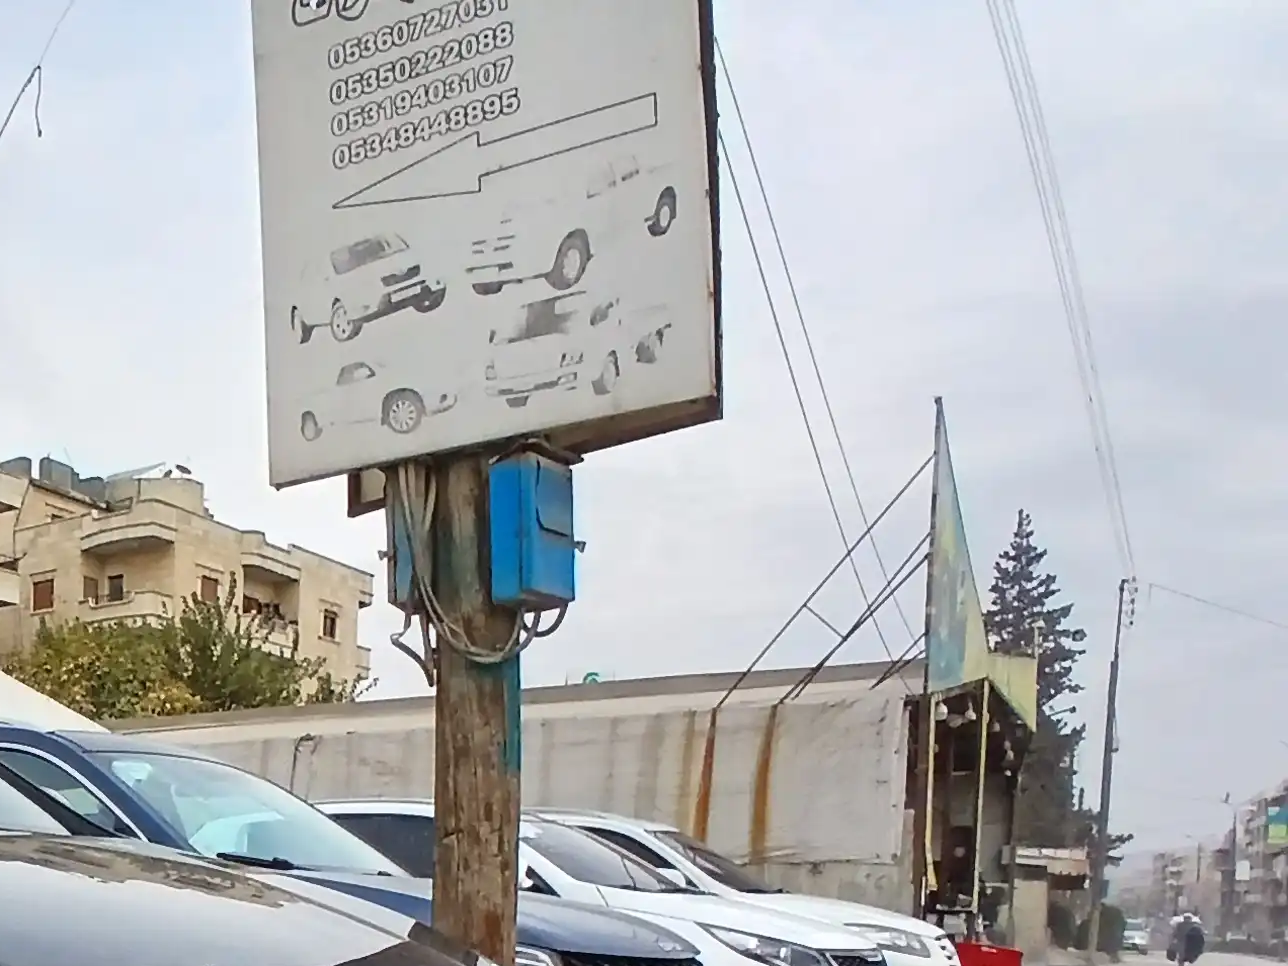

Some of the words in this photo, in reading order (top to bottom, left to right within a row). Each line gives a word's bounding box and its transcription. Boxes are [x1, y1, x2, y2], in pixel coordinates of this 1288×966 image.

[329, 21, 514, 104] 05350222088
[331, 55, 514, 136] 05319403107
[332, 87, 520, 169] 05348448895
